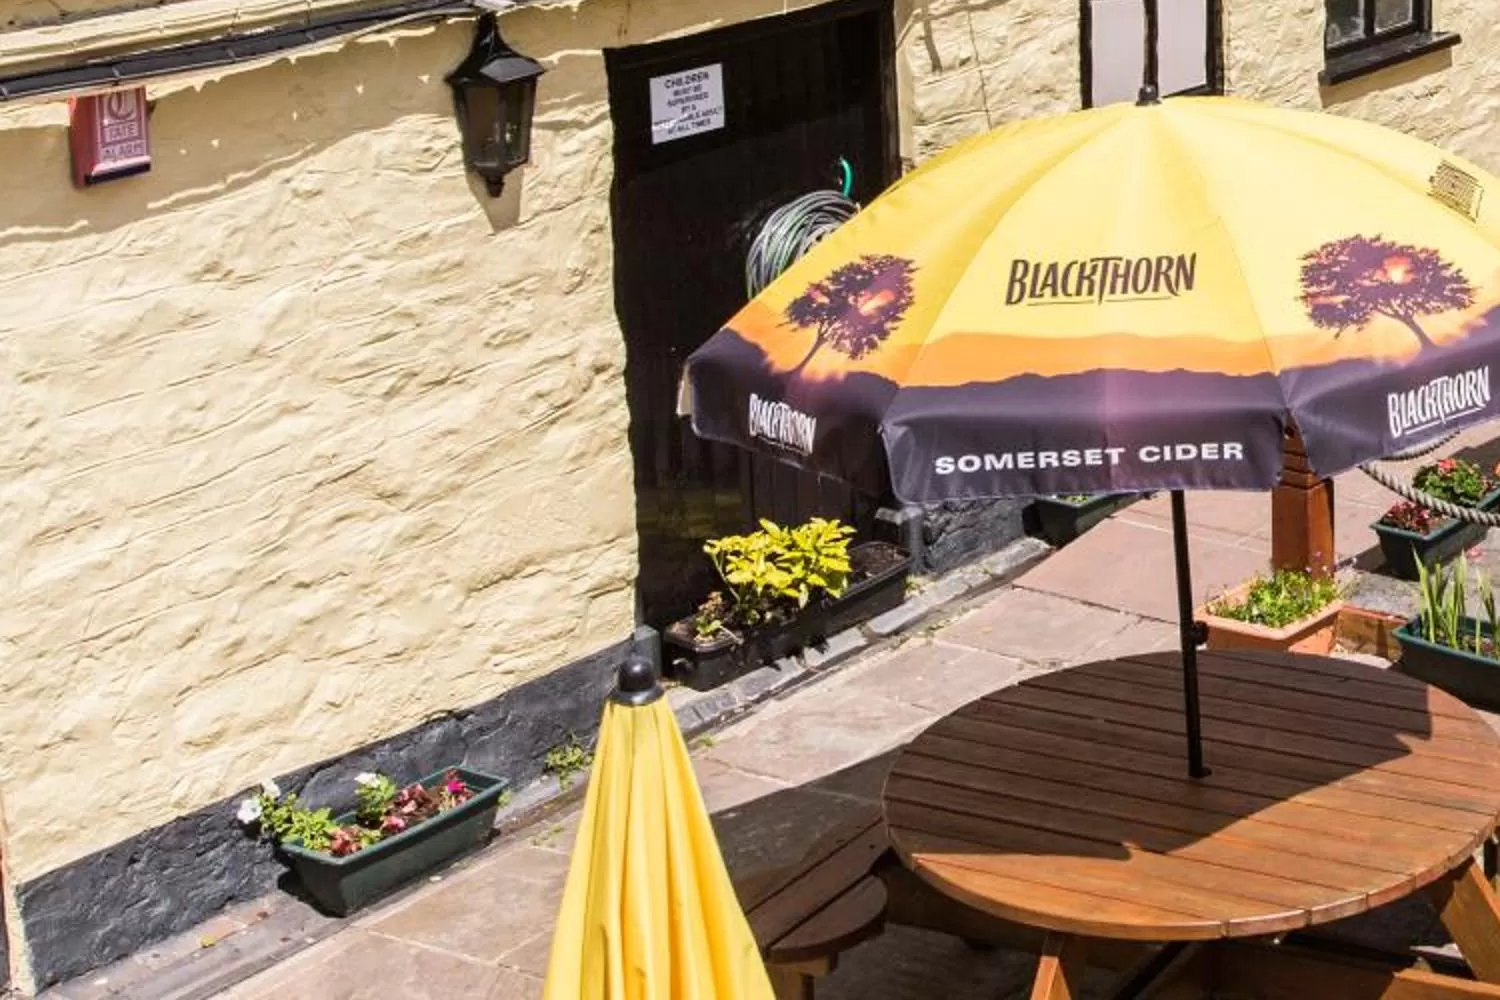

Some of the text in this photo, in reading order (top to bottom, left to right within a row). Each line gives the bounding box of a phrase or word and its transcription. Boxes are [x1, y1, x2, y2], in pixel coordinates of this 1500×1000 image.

[1004, 252, 1197, 306] BLACKTHORN
[749, 393, 816, 456] BLACKTHORN
[1388, 365, 1491, 438] BLACKTHORN
[934, 442, 1244, 475] SOMERSET CIDER
